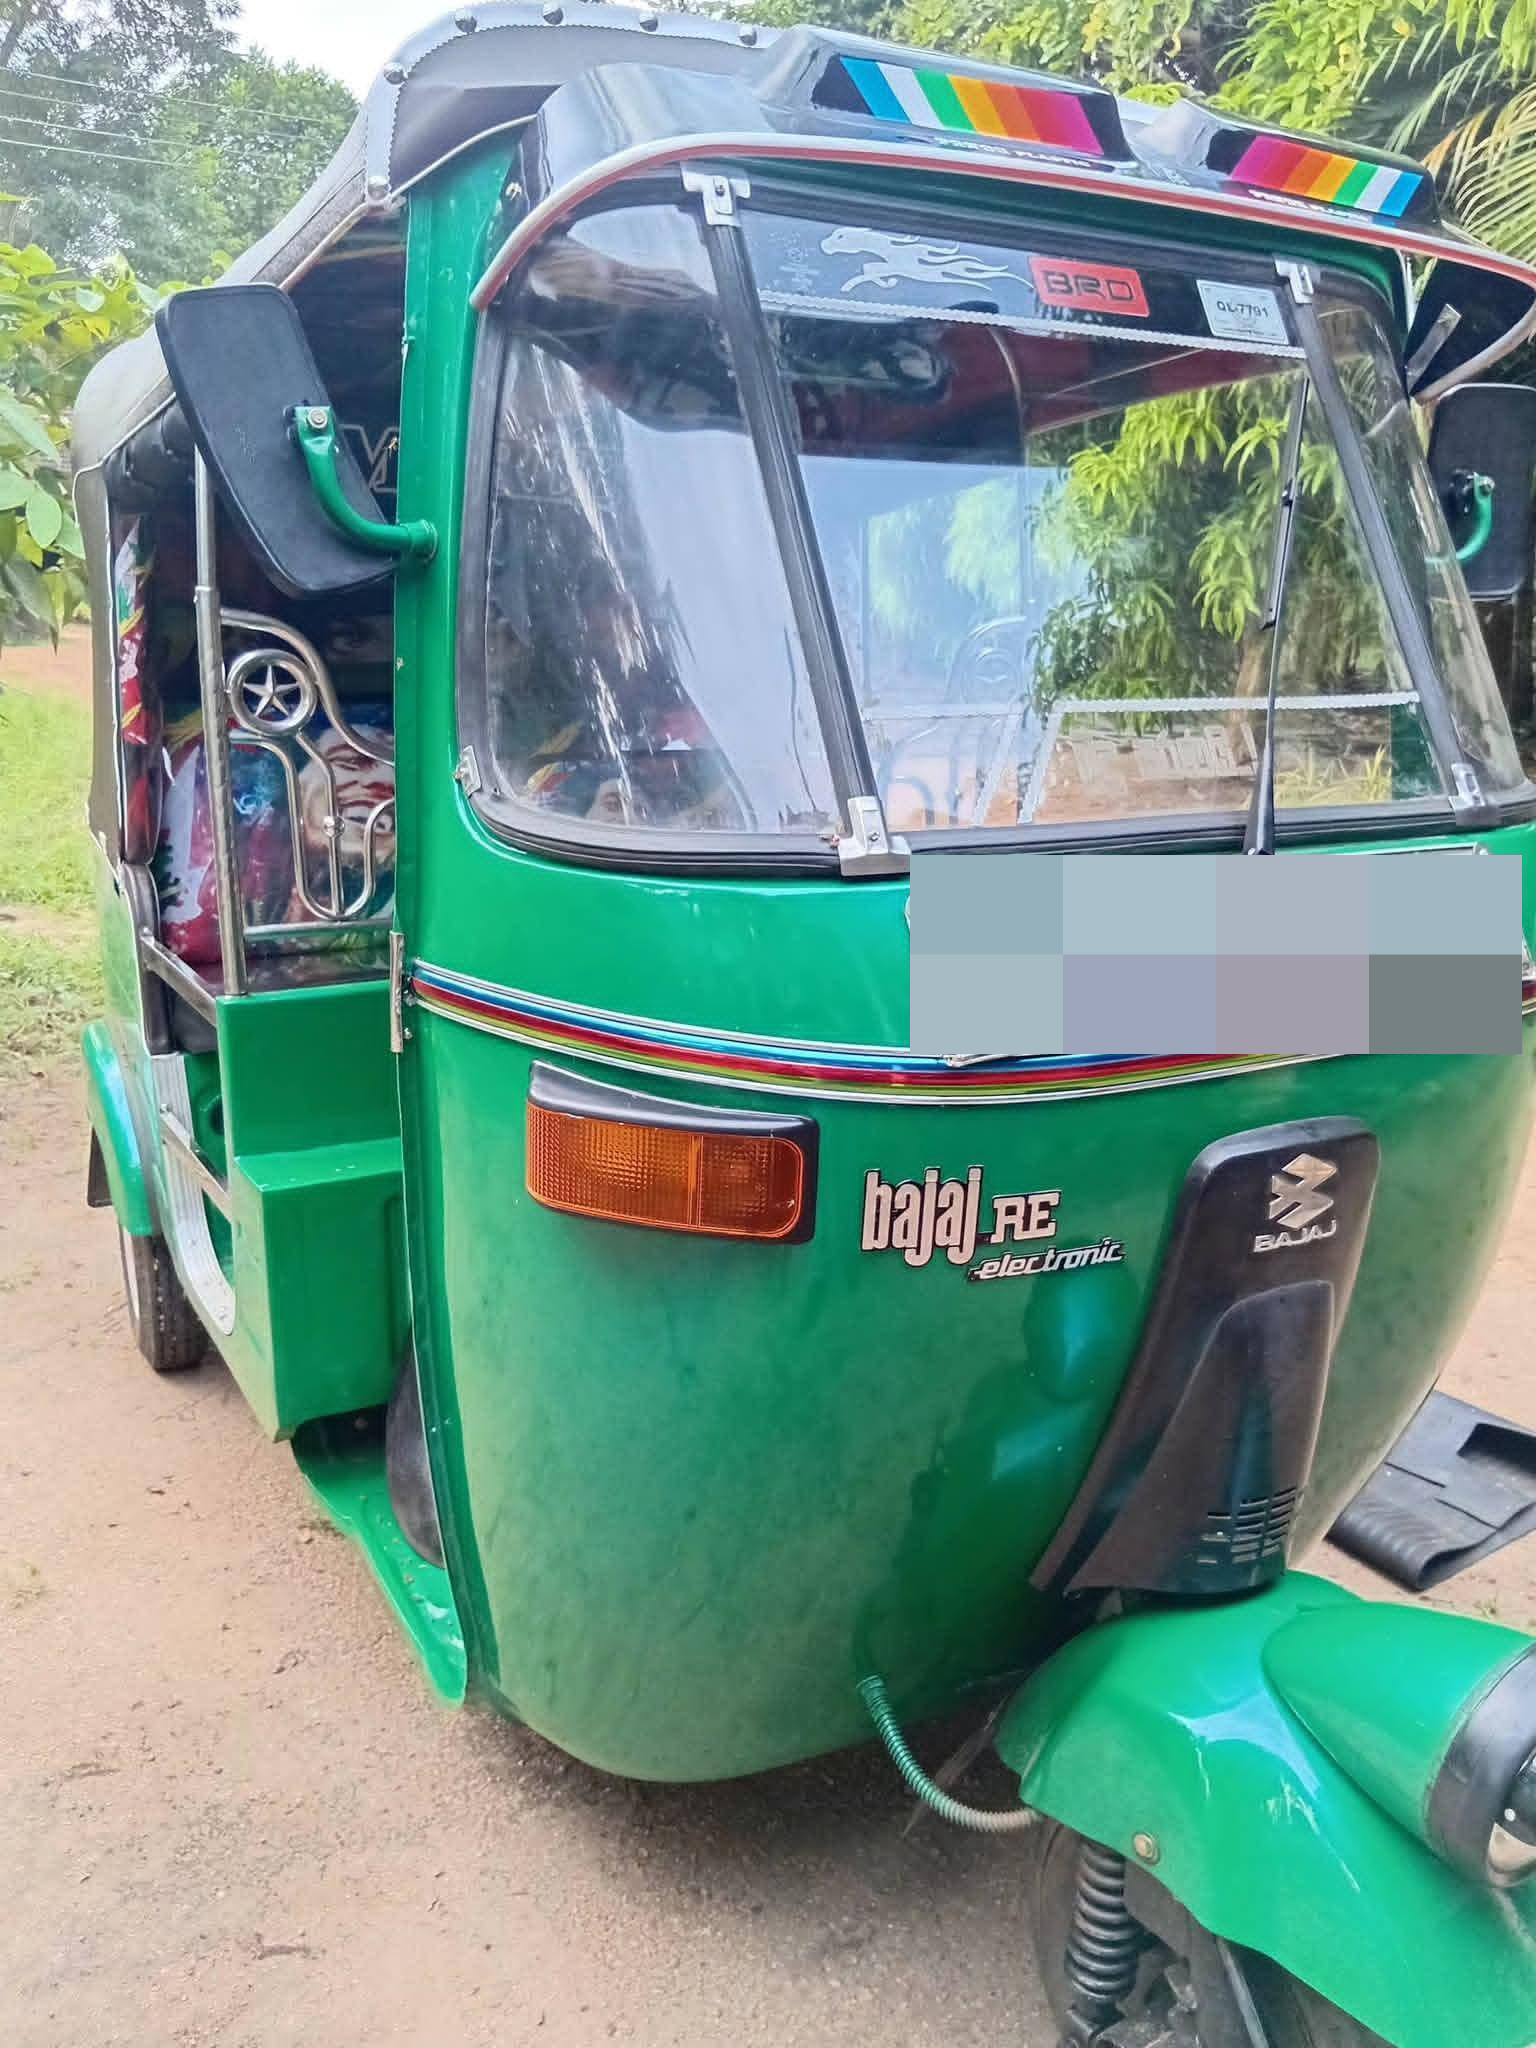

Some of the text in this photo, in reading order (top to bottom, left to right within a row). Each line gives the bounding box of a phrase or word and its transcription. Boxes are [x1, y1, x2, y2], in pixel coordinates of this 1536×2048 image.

[1041, 269, 1135, 301] BRD
[861, 1166, 1062, 1267] bajaj RE
[1252, 1218, 1338, 1254] BAJAJ
[969, 1237, 1125, 1281] electronic
